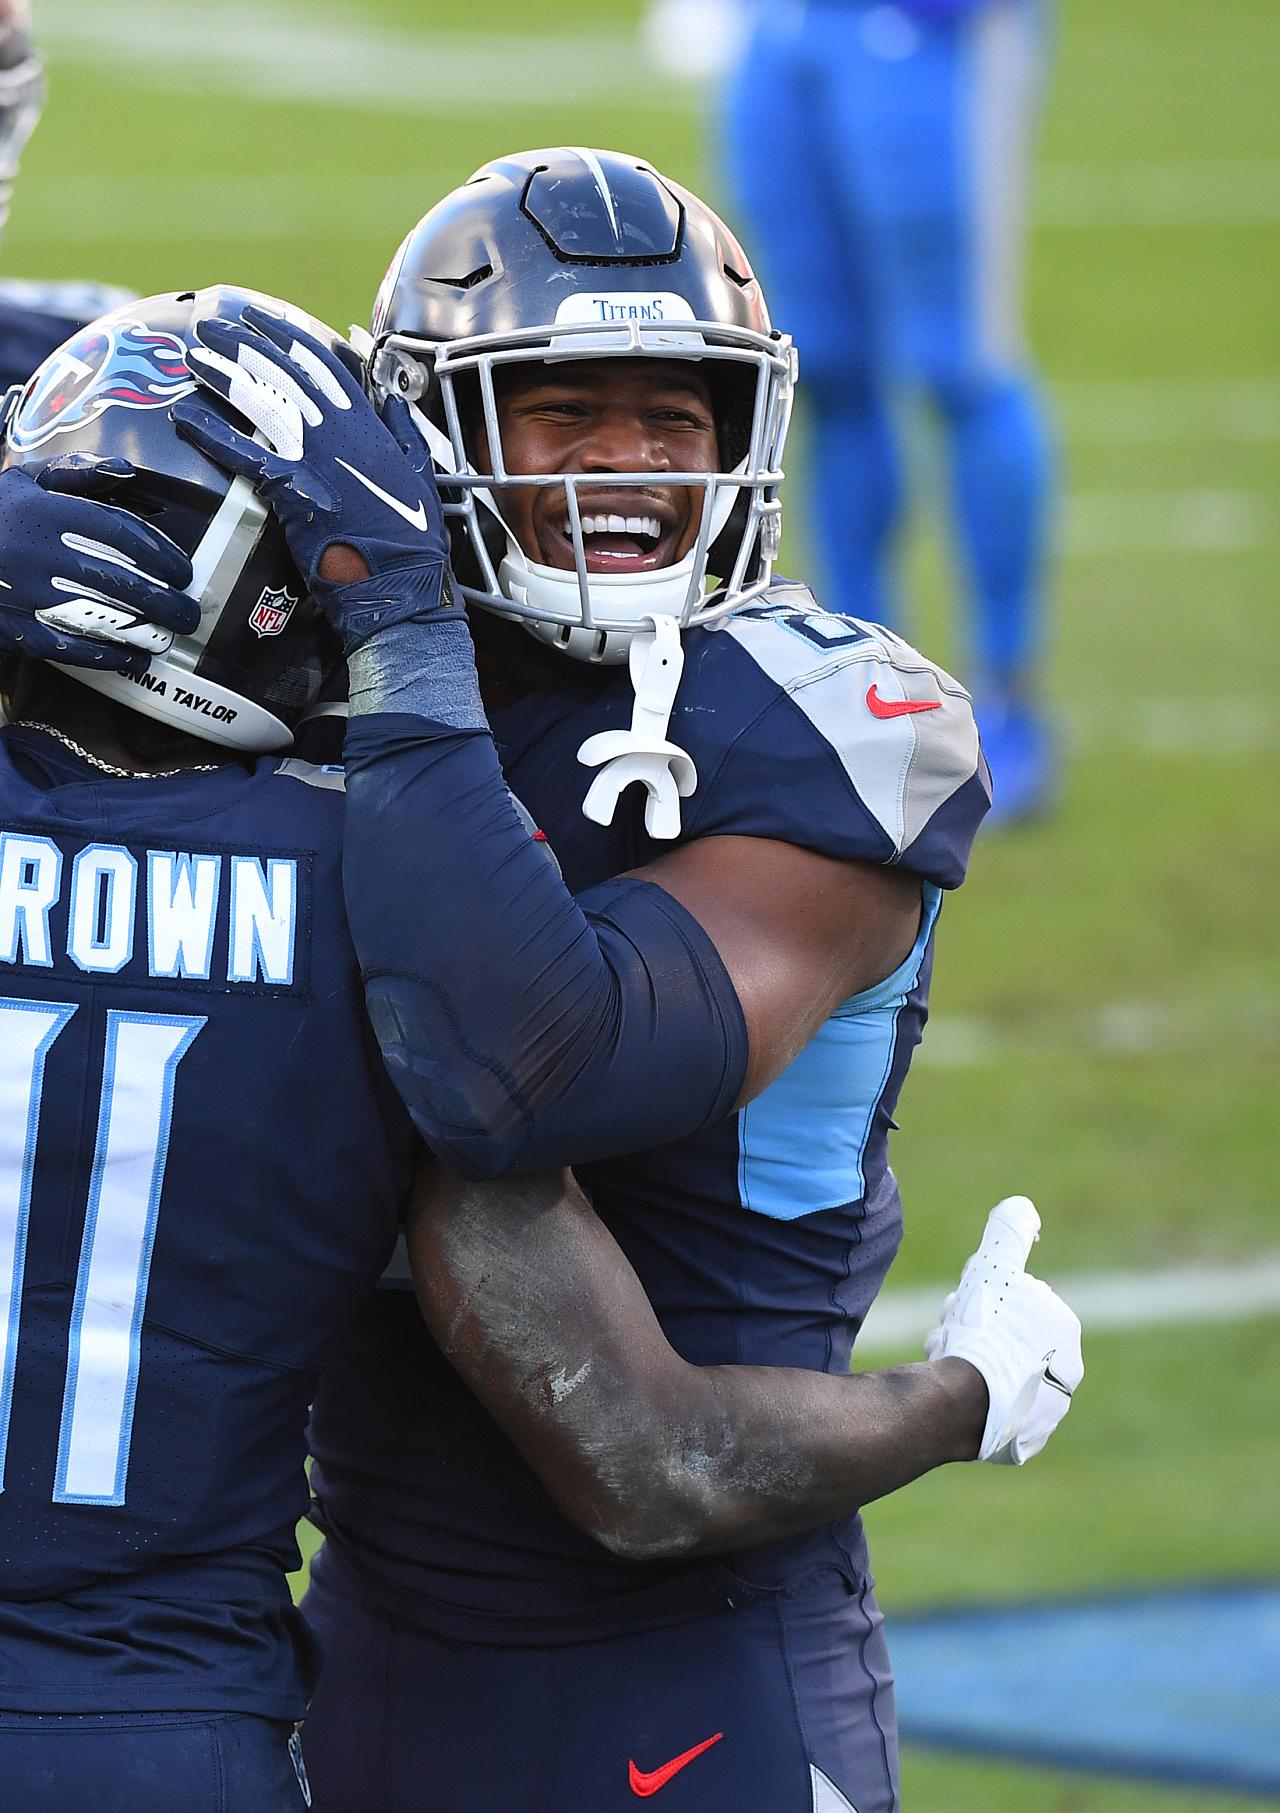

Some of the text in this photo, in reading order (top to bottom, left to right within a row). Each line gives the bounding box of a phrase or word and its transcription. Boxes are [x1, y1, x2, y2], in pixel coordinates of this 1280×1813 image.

[593, 300, 664, 321] TITANS
[253, 606, 283, 630] NFL
[172, 687, 238, 724] TAYLOR
